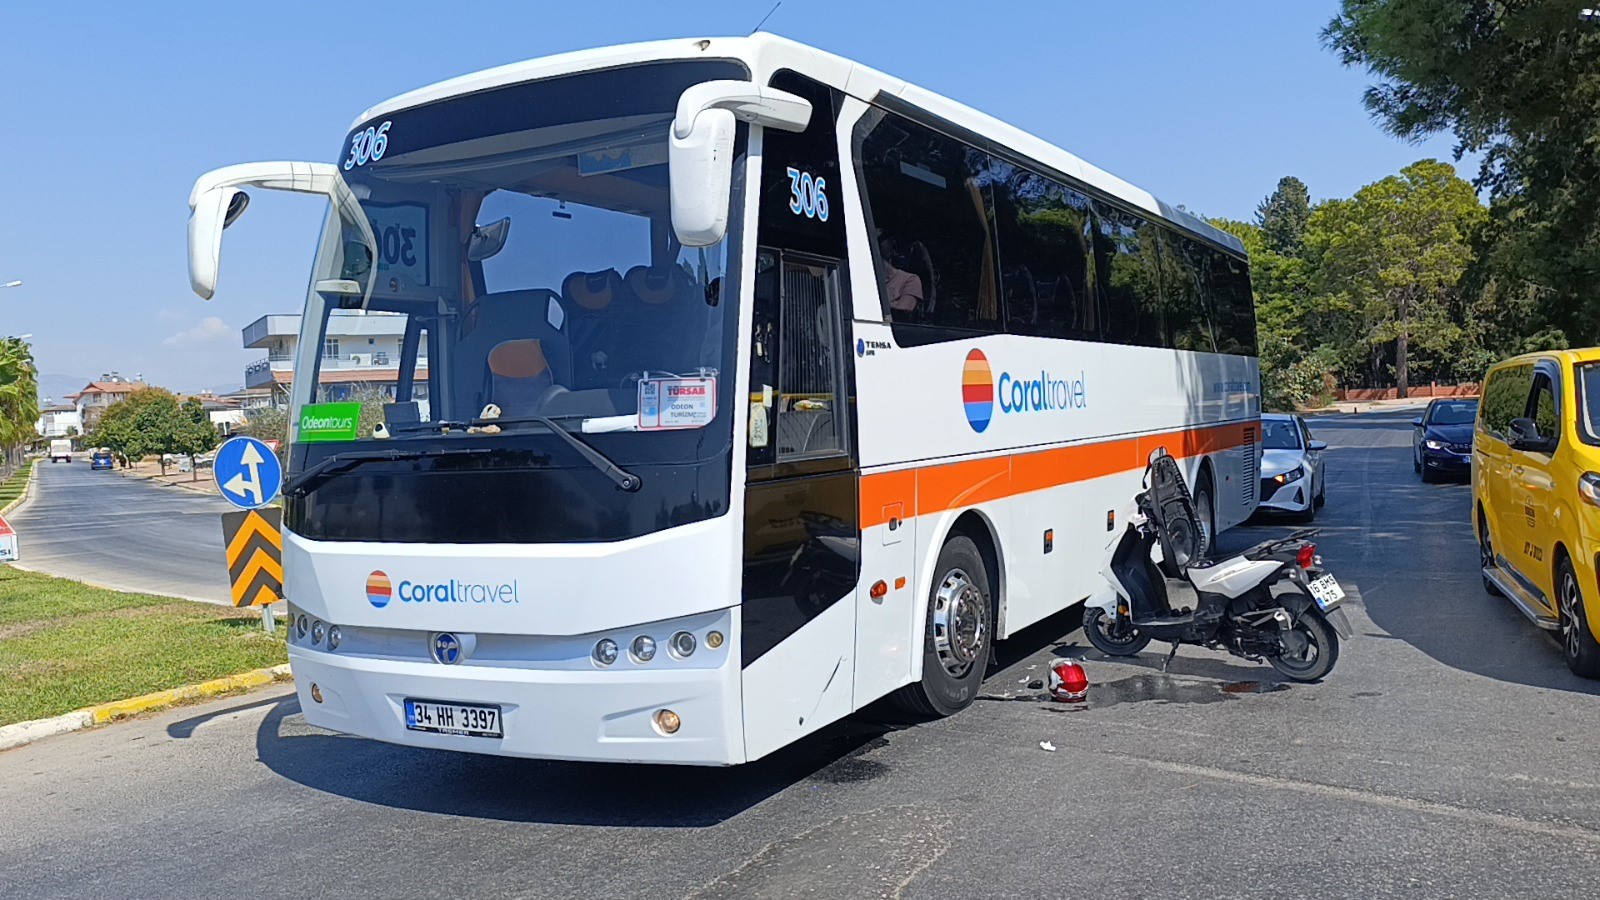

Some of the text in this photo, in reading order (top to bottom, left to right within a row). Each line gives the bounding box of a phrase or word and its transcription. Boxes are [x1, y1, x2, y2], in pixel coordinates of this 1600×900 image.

[344, 121, 392, 170] 306
[787, 166, 829, 222] 306
[865, 341, 891, 349] TEMSA
[998, 370, 1087, 414] Coraltravel
[302, 416, 353, 429] Odeontours
[398, 579, 519, 603] Coraltravel
[1310, 583, 1320, 594] 16
[1323, 590, 1338, 602] 475
[415, 704, 495, 730] 34 HH 3397
